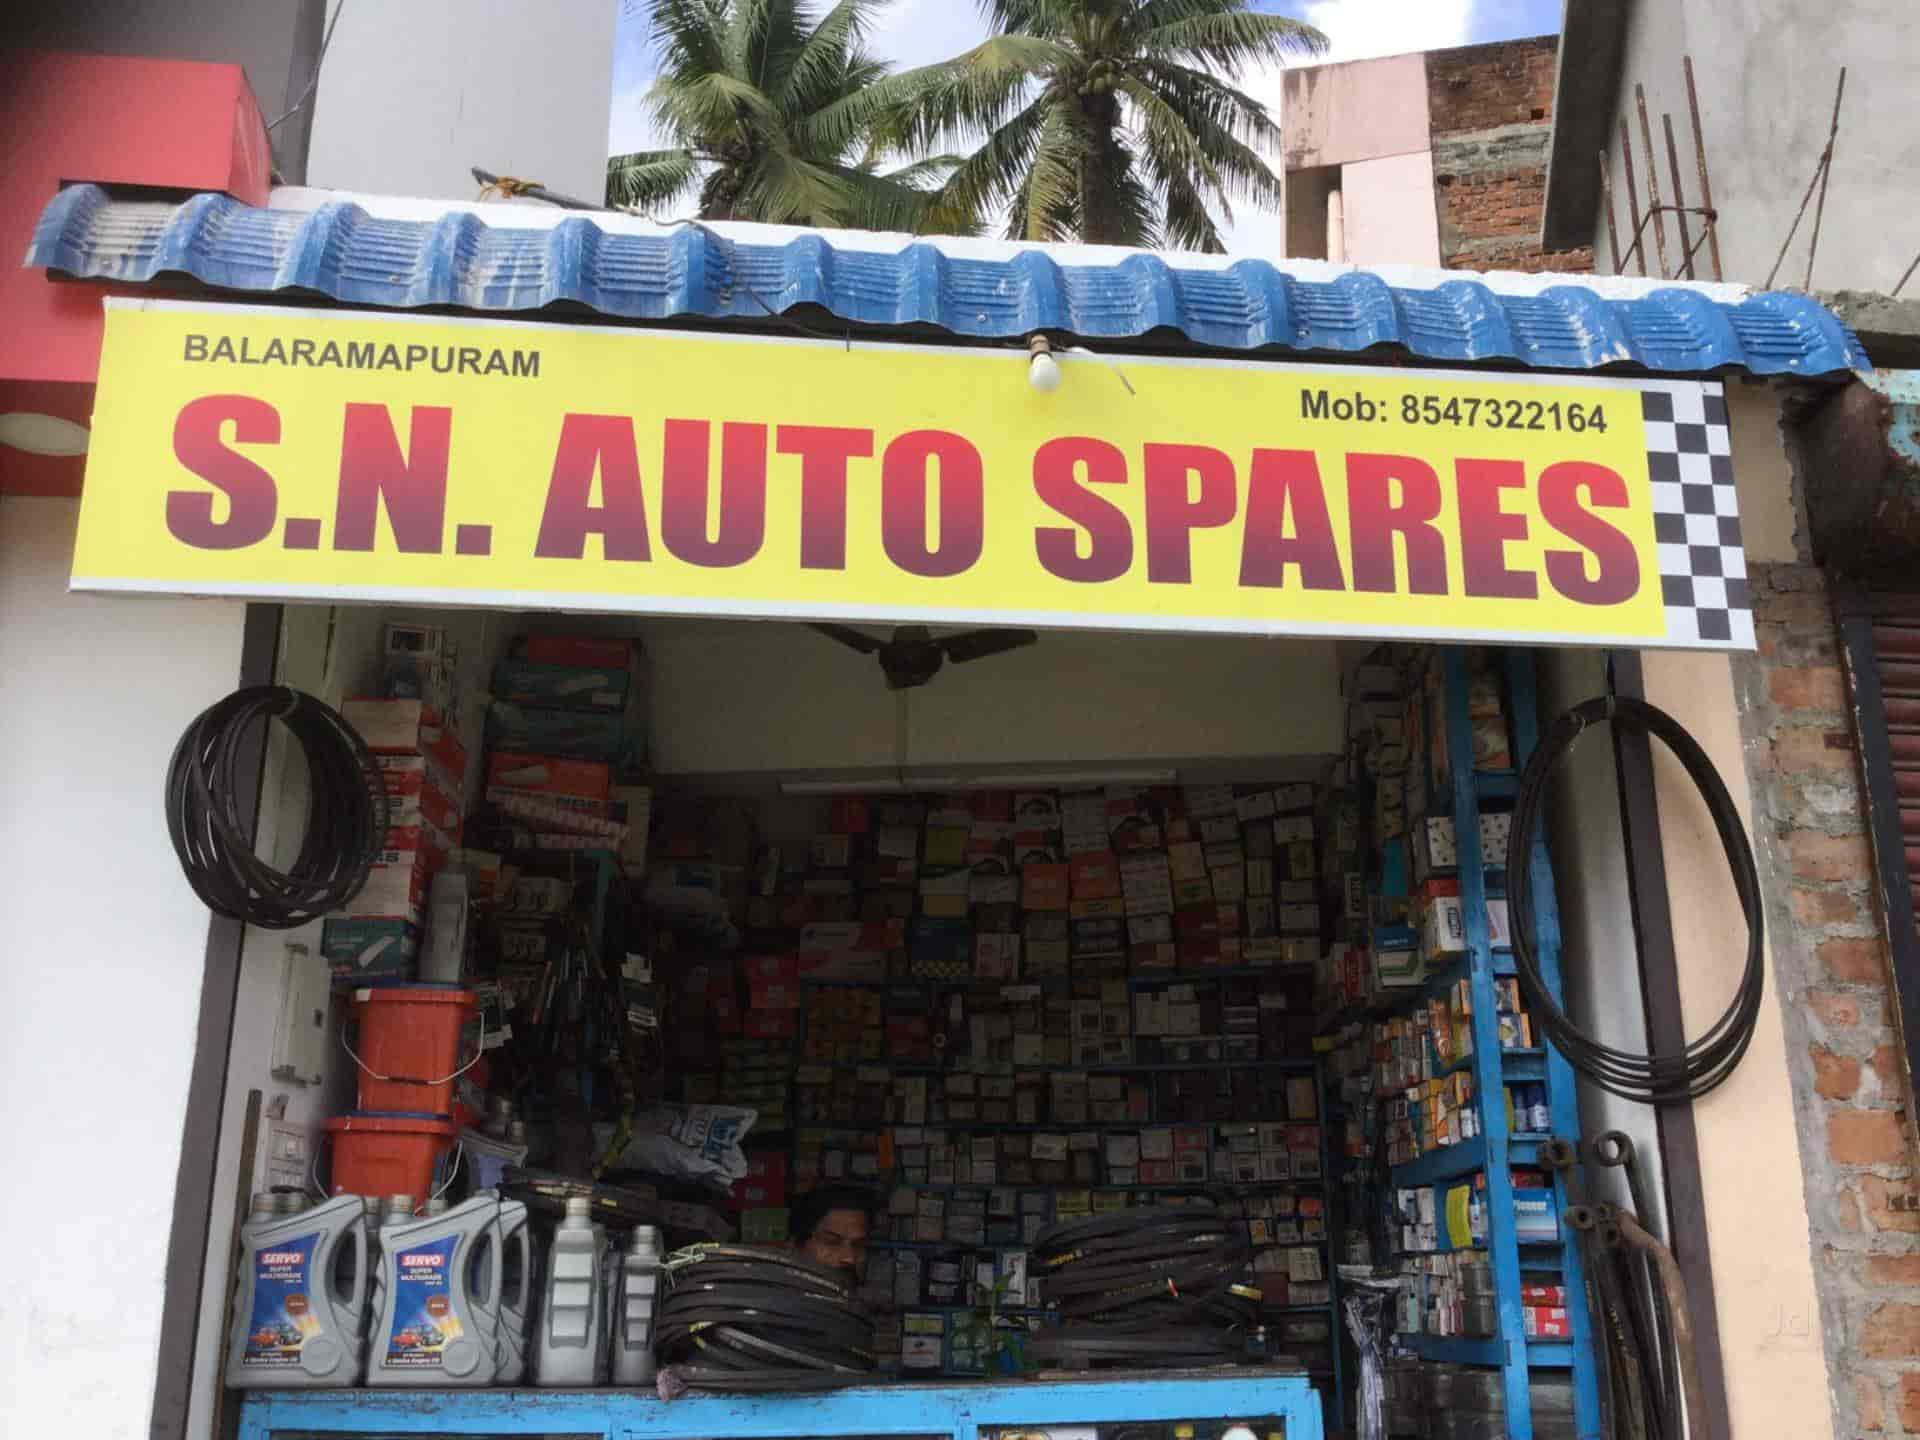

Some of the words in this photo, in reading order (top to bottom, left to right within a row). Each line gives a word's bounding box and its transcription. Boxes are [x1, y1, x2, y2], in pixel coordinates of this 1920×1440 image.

[184, 334, 540, 377] BALARAMAPURAM
[1300, 388, 1388, 423] Mob:
[1401, 394, 1608, 434] 8547322164
[165, 394, 493, 556] S.N.
[533, 413, 985, 578] AUTO
[1032, 436, 1641, 606] SPARES
[262, 1253, 301, 1264] SERVO
[402, 1255, 441, 1266] SERVO
